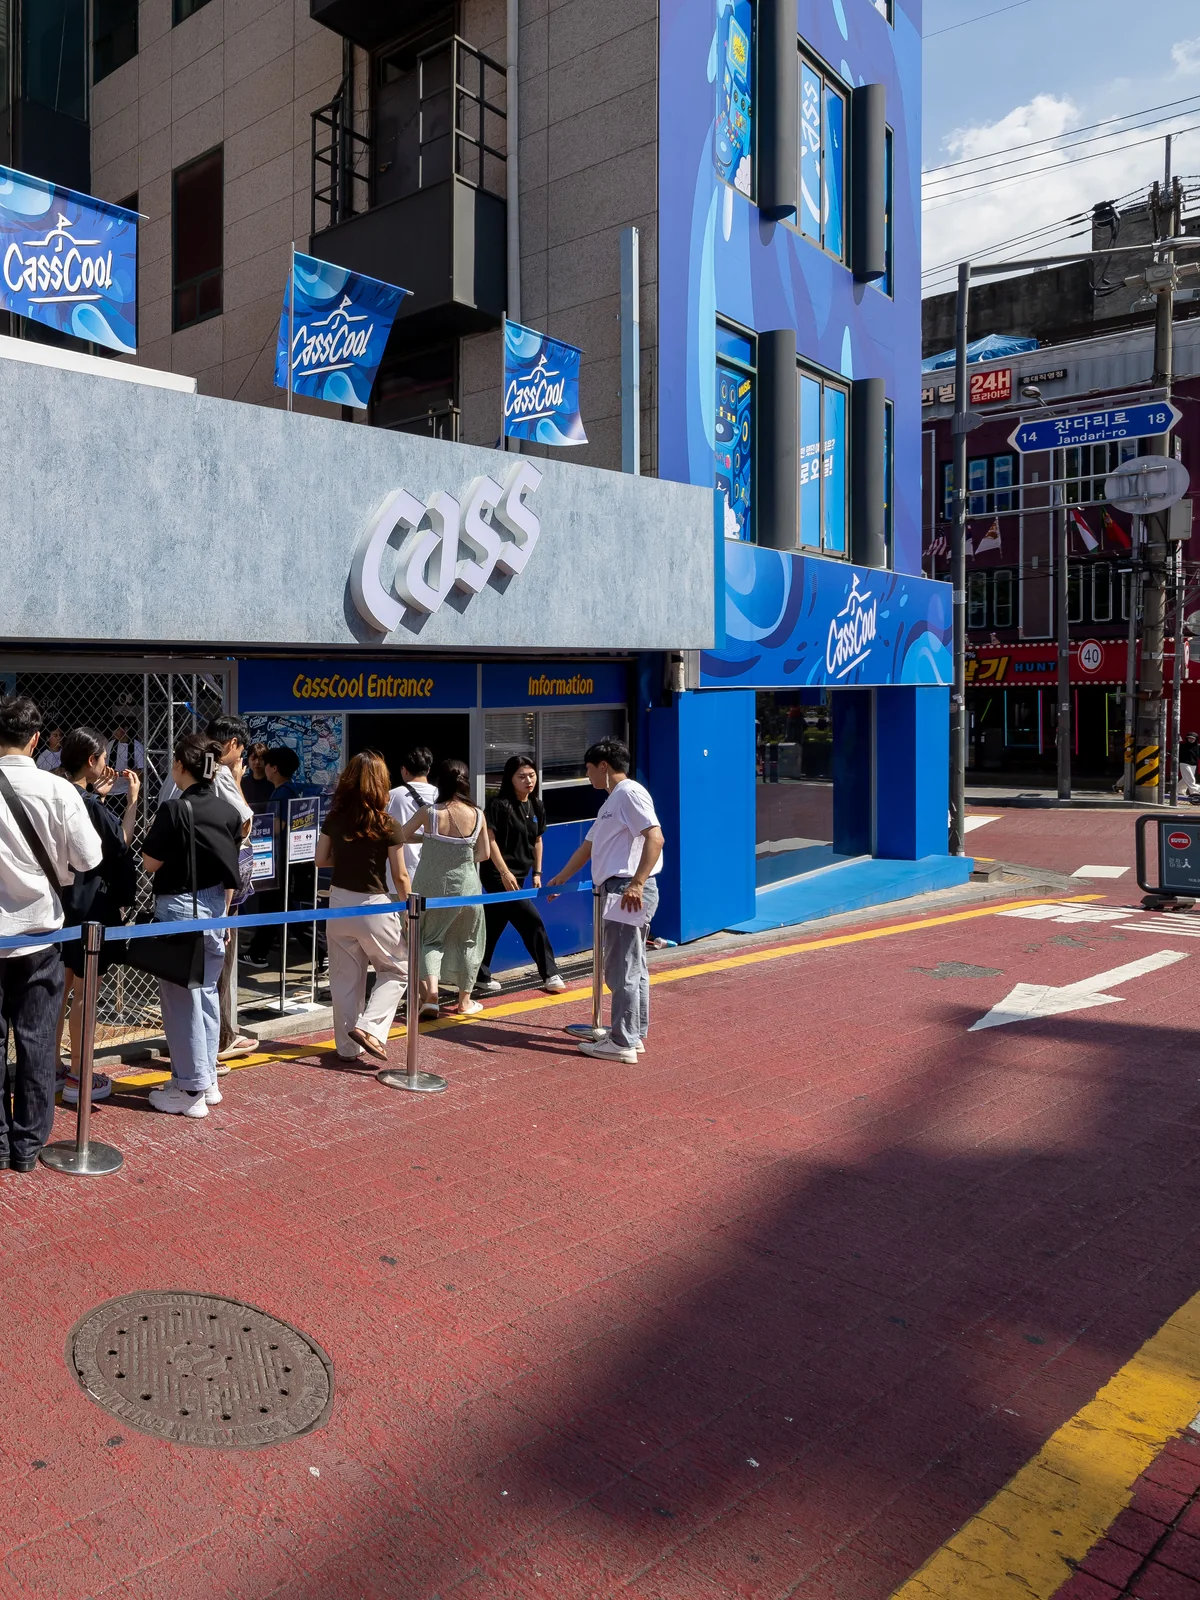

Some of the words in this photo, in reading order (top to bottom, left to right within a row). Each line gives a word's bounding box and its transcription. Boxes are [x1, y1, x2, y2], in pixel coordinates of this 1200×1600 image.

[3, 242, 113, 292] CassCool
[291, 324, 374, 370] CassCool
[970, 369, 1011, 394] 24H
[1022, 370, 1064, 384] 홍대직영점
[504, 378, 565, 417] CassCool
[971, 388, 1010, 402] 프라이빗
[1054, 412, 1130, 435] 잔다리로
[1147, 412, 1166, 425] 18
[1021, 432, 1038, 443] 14
[1057, 428, 1127, 445] Jandari-ro
[826, 599, 877, 675] CassCool
[1014, 661, 1056, 672] HUNT
[1084, 648, 1099, 663] 40
[292, 672, 364, 698] CassCool
[367, 674, 434, 698] Entrance
[528, 673, 594, 696] Information
